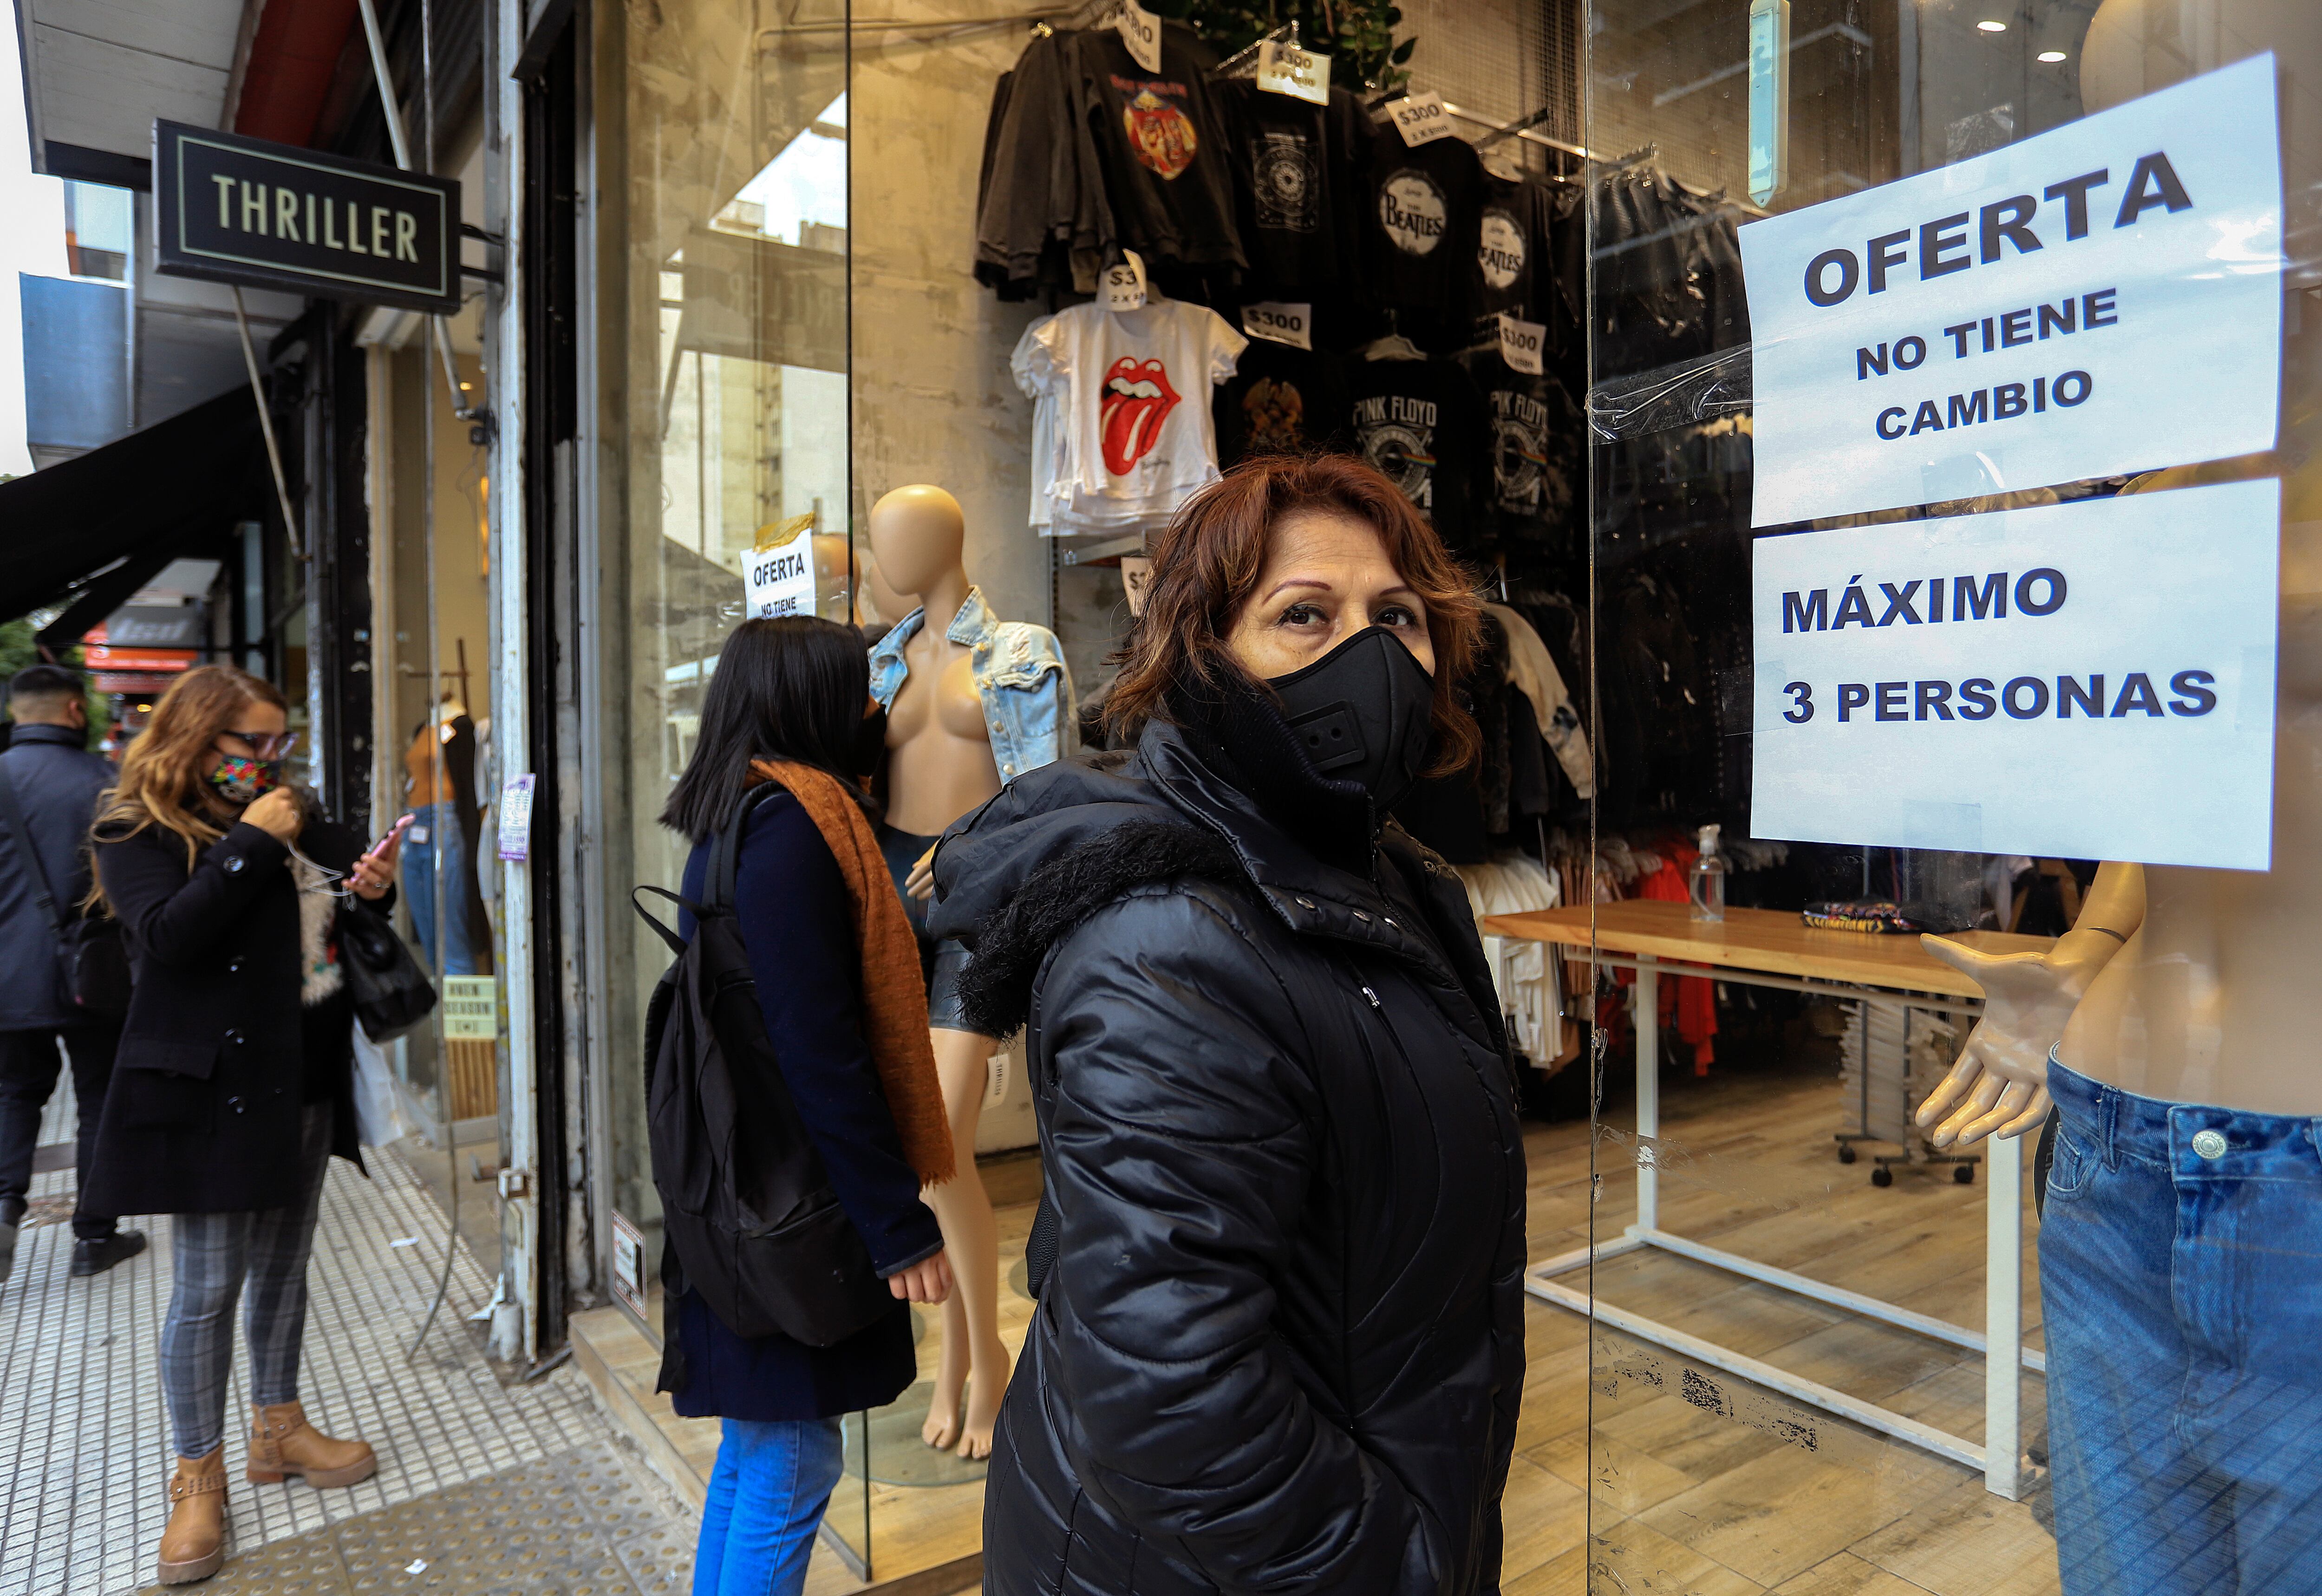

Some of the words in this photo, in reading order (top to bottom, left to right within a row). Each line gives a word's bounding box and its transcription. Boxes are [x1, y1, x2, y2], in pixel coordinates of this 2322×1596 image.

[1398, 104, 1439, 126] $300
[211, 174, 418, 264] THRILLER
[1387, 194, 1442, 240] BEATLES
[1804, 151, 2193, 307] OFERTA
[1248, 309, 1301, 332] $300
[1502, 326, 1537, 351] $300
[1857, 336, 1927, 380] NO
[1944, 288, 2118, 359] TIENE
[1352, 396, 1387, 426] PINK
[1391, 395, 1437, 427] FLOYD
[1875, 370, 2093, 440] CAMBIO
[754, 553, 805, 586] OFERTA
[761, 603, 772, 617] NO
[773, 596, 796, 614] TIENE
[1782, 567, 2068, 633] MÁXIMO
[1783, 681, 1814, 723] 3
[1838, 670, 2217, 723] PERSONAS
